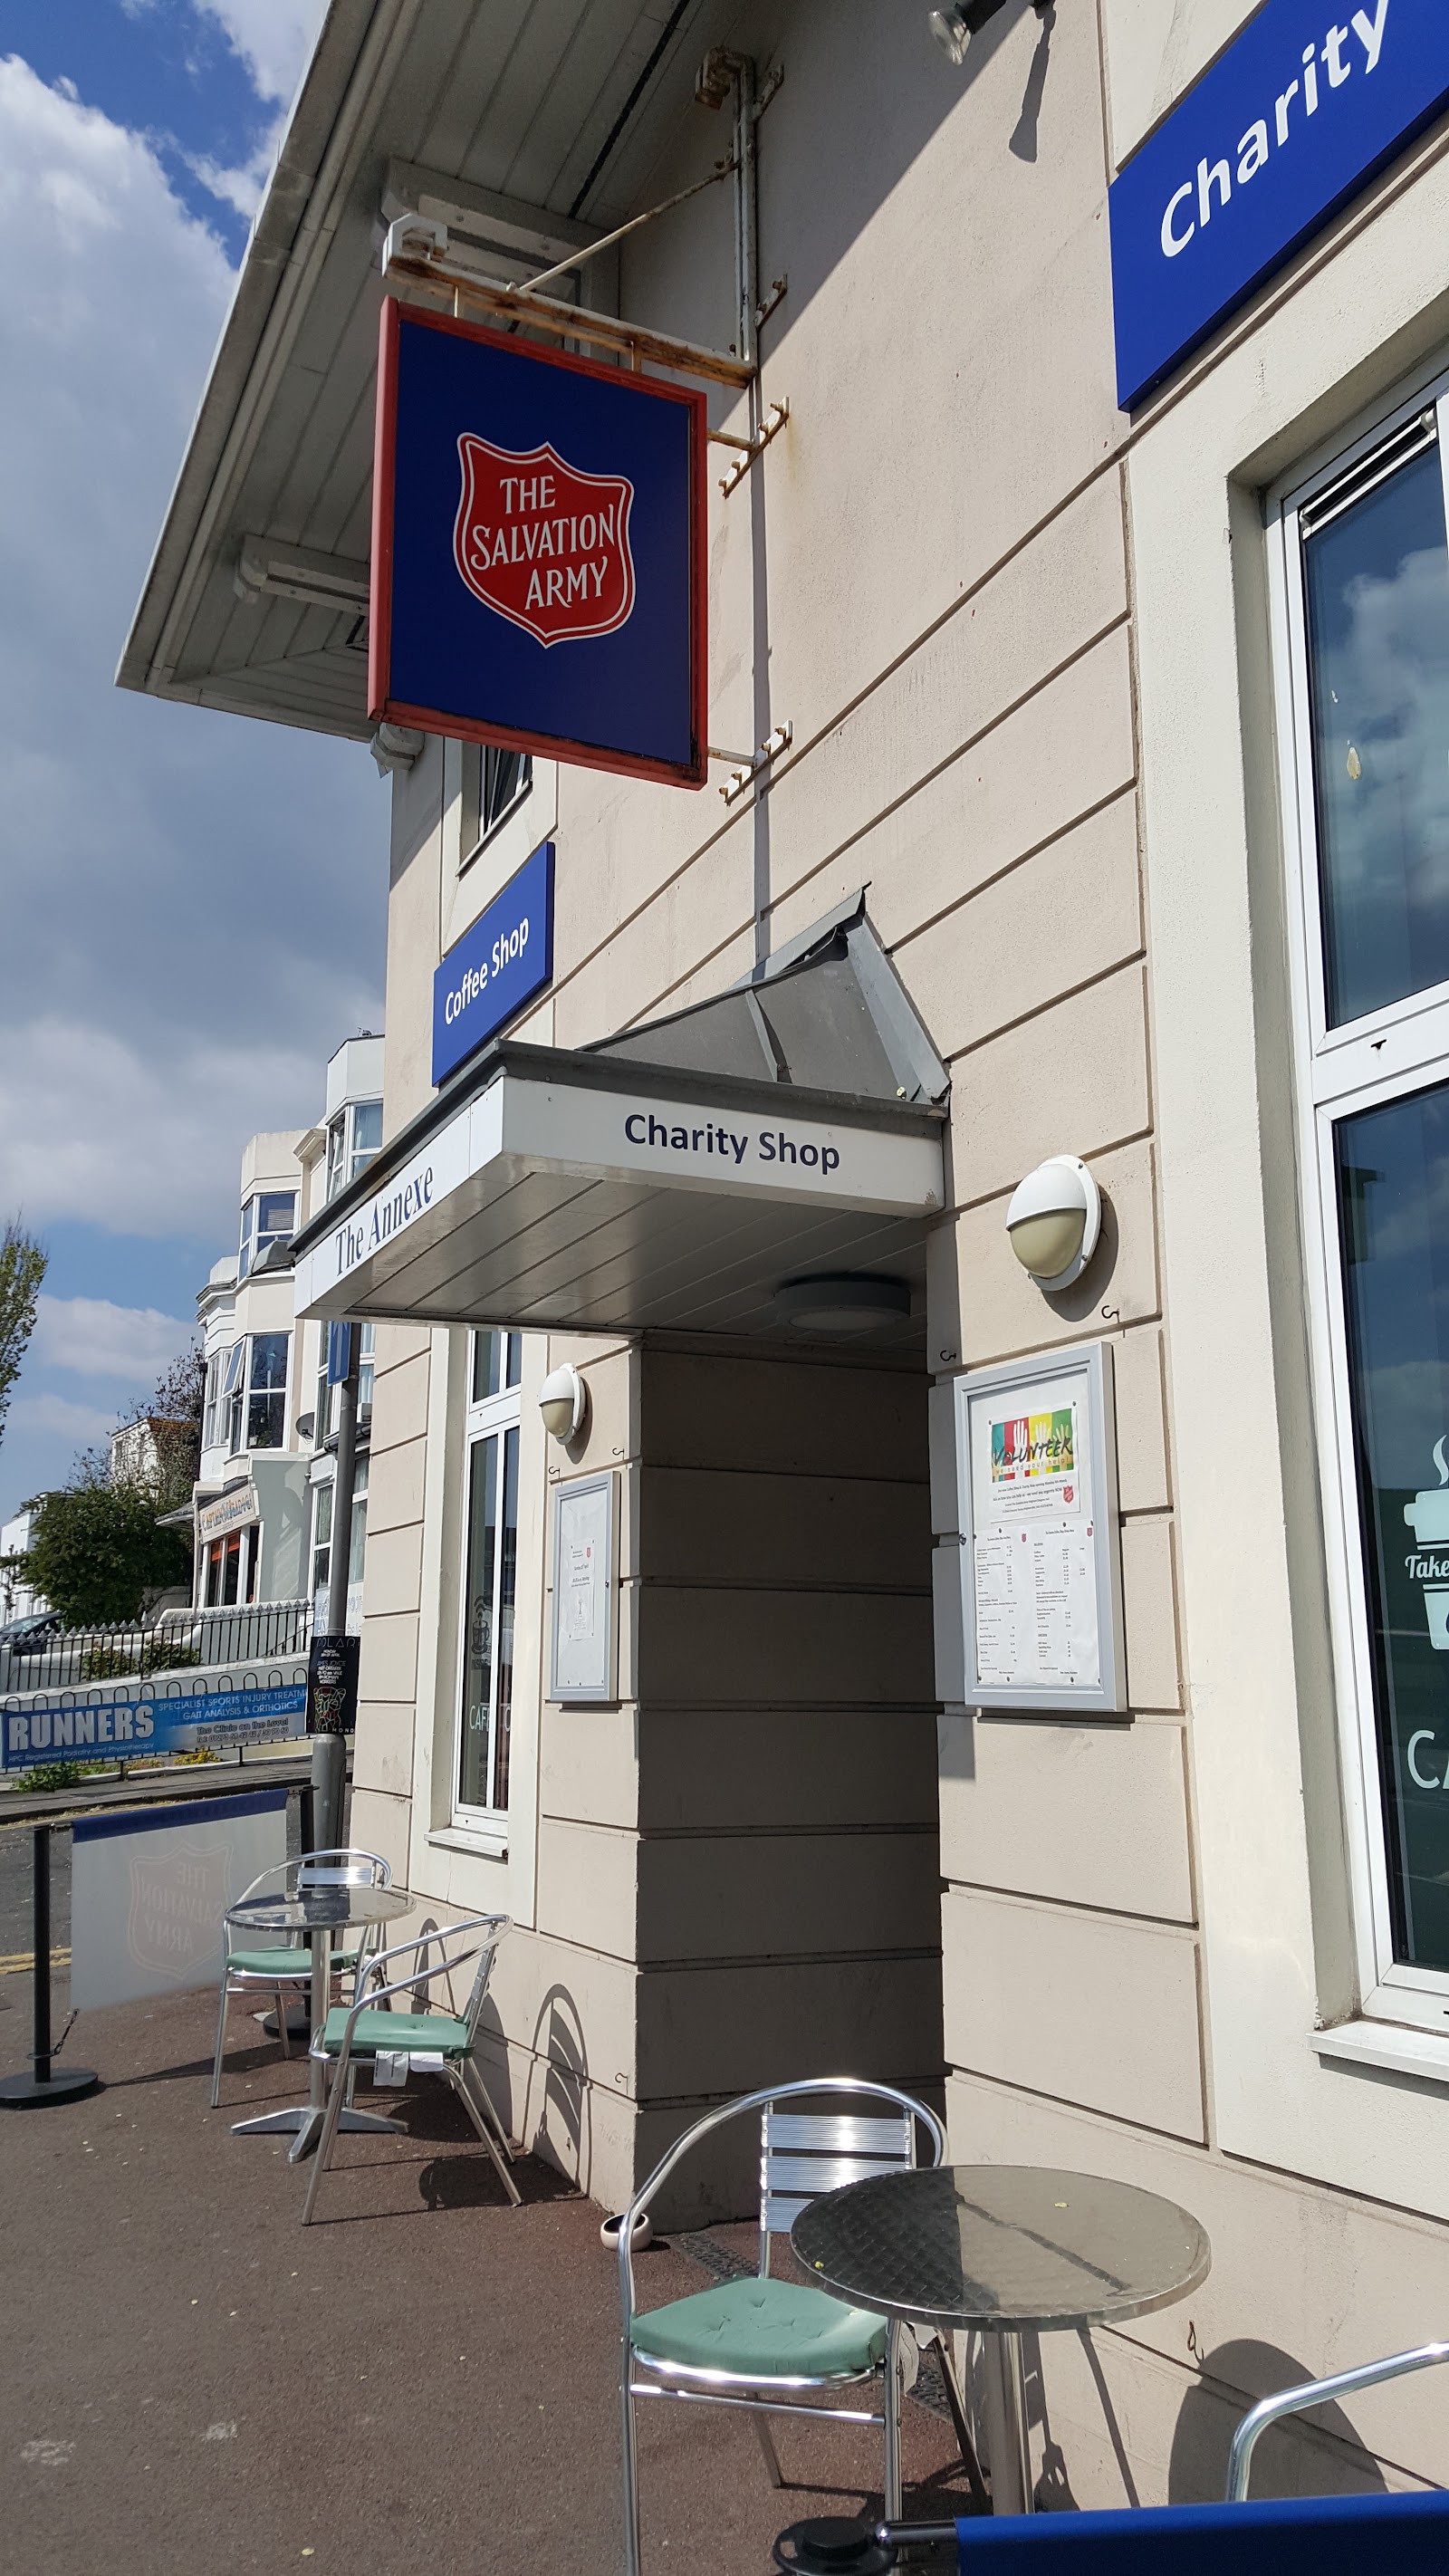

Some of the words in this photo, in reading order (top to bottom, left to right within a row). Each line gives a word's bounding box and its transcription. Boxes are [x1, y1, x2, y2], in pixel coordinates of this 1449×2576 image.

[1160, 0, 1389, 257] Charity
[500, 476, 557, 514] THE
[470, 504, 615, 571] SALVATION
[524, 555, 608, 610] ARMY
[445, 962, 488, 1025] Coffee
[491, 918, 530, 978] Shop
[625, 1114, 748, 1164] Charity
[759, 1132, 840, 1175] Shop
[335, 1224, 363, 1276] The
[368, 1167, 433, 1252] Annexe
[993, 1436, 1073, 1466] VOLUNTEER
[1405, 1554, 1449, 1579] Take
[158, 1698, 205, 1711] SPECIALIST
[208, 1696, 240, 1706] SPORTS
[243, 1692, 273, 1703] INJURY
[274, 1689, 306, 1699] TREATM
[183, 1710, 202, 1720] GAIT
[204, 1706, 241, 1717] ANALYSIS
[244, 1706, 250, 1714] &
[252, 1701, 298, 1713] ORTHOTICS
[8, 1705, 154, 1752] RUNNERS
[197, 1726, 212, 1735] The
[213, 1723, 238, 1734] Clinic
[239, 1723, 251, 1731] on
[252, 1719, 265, 1729] the
[267, 1717, 289, 1727] Level
[24, 1752, 62, 1762] Registered
[63, 1747, 91, 1758] Podiatry
[93, 1746, 107, 1754] and
[108, 1743, 154, 1754] Physiotherapy
